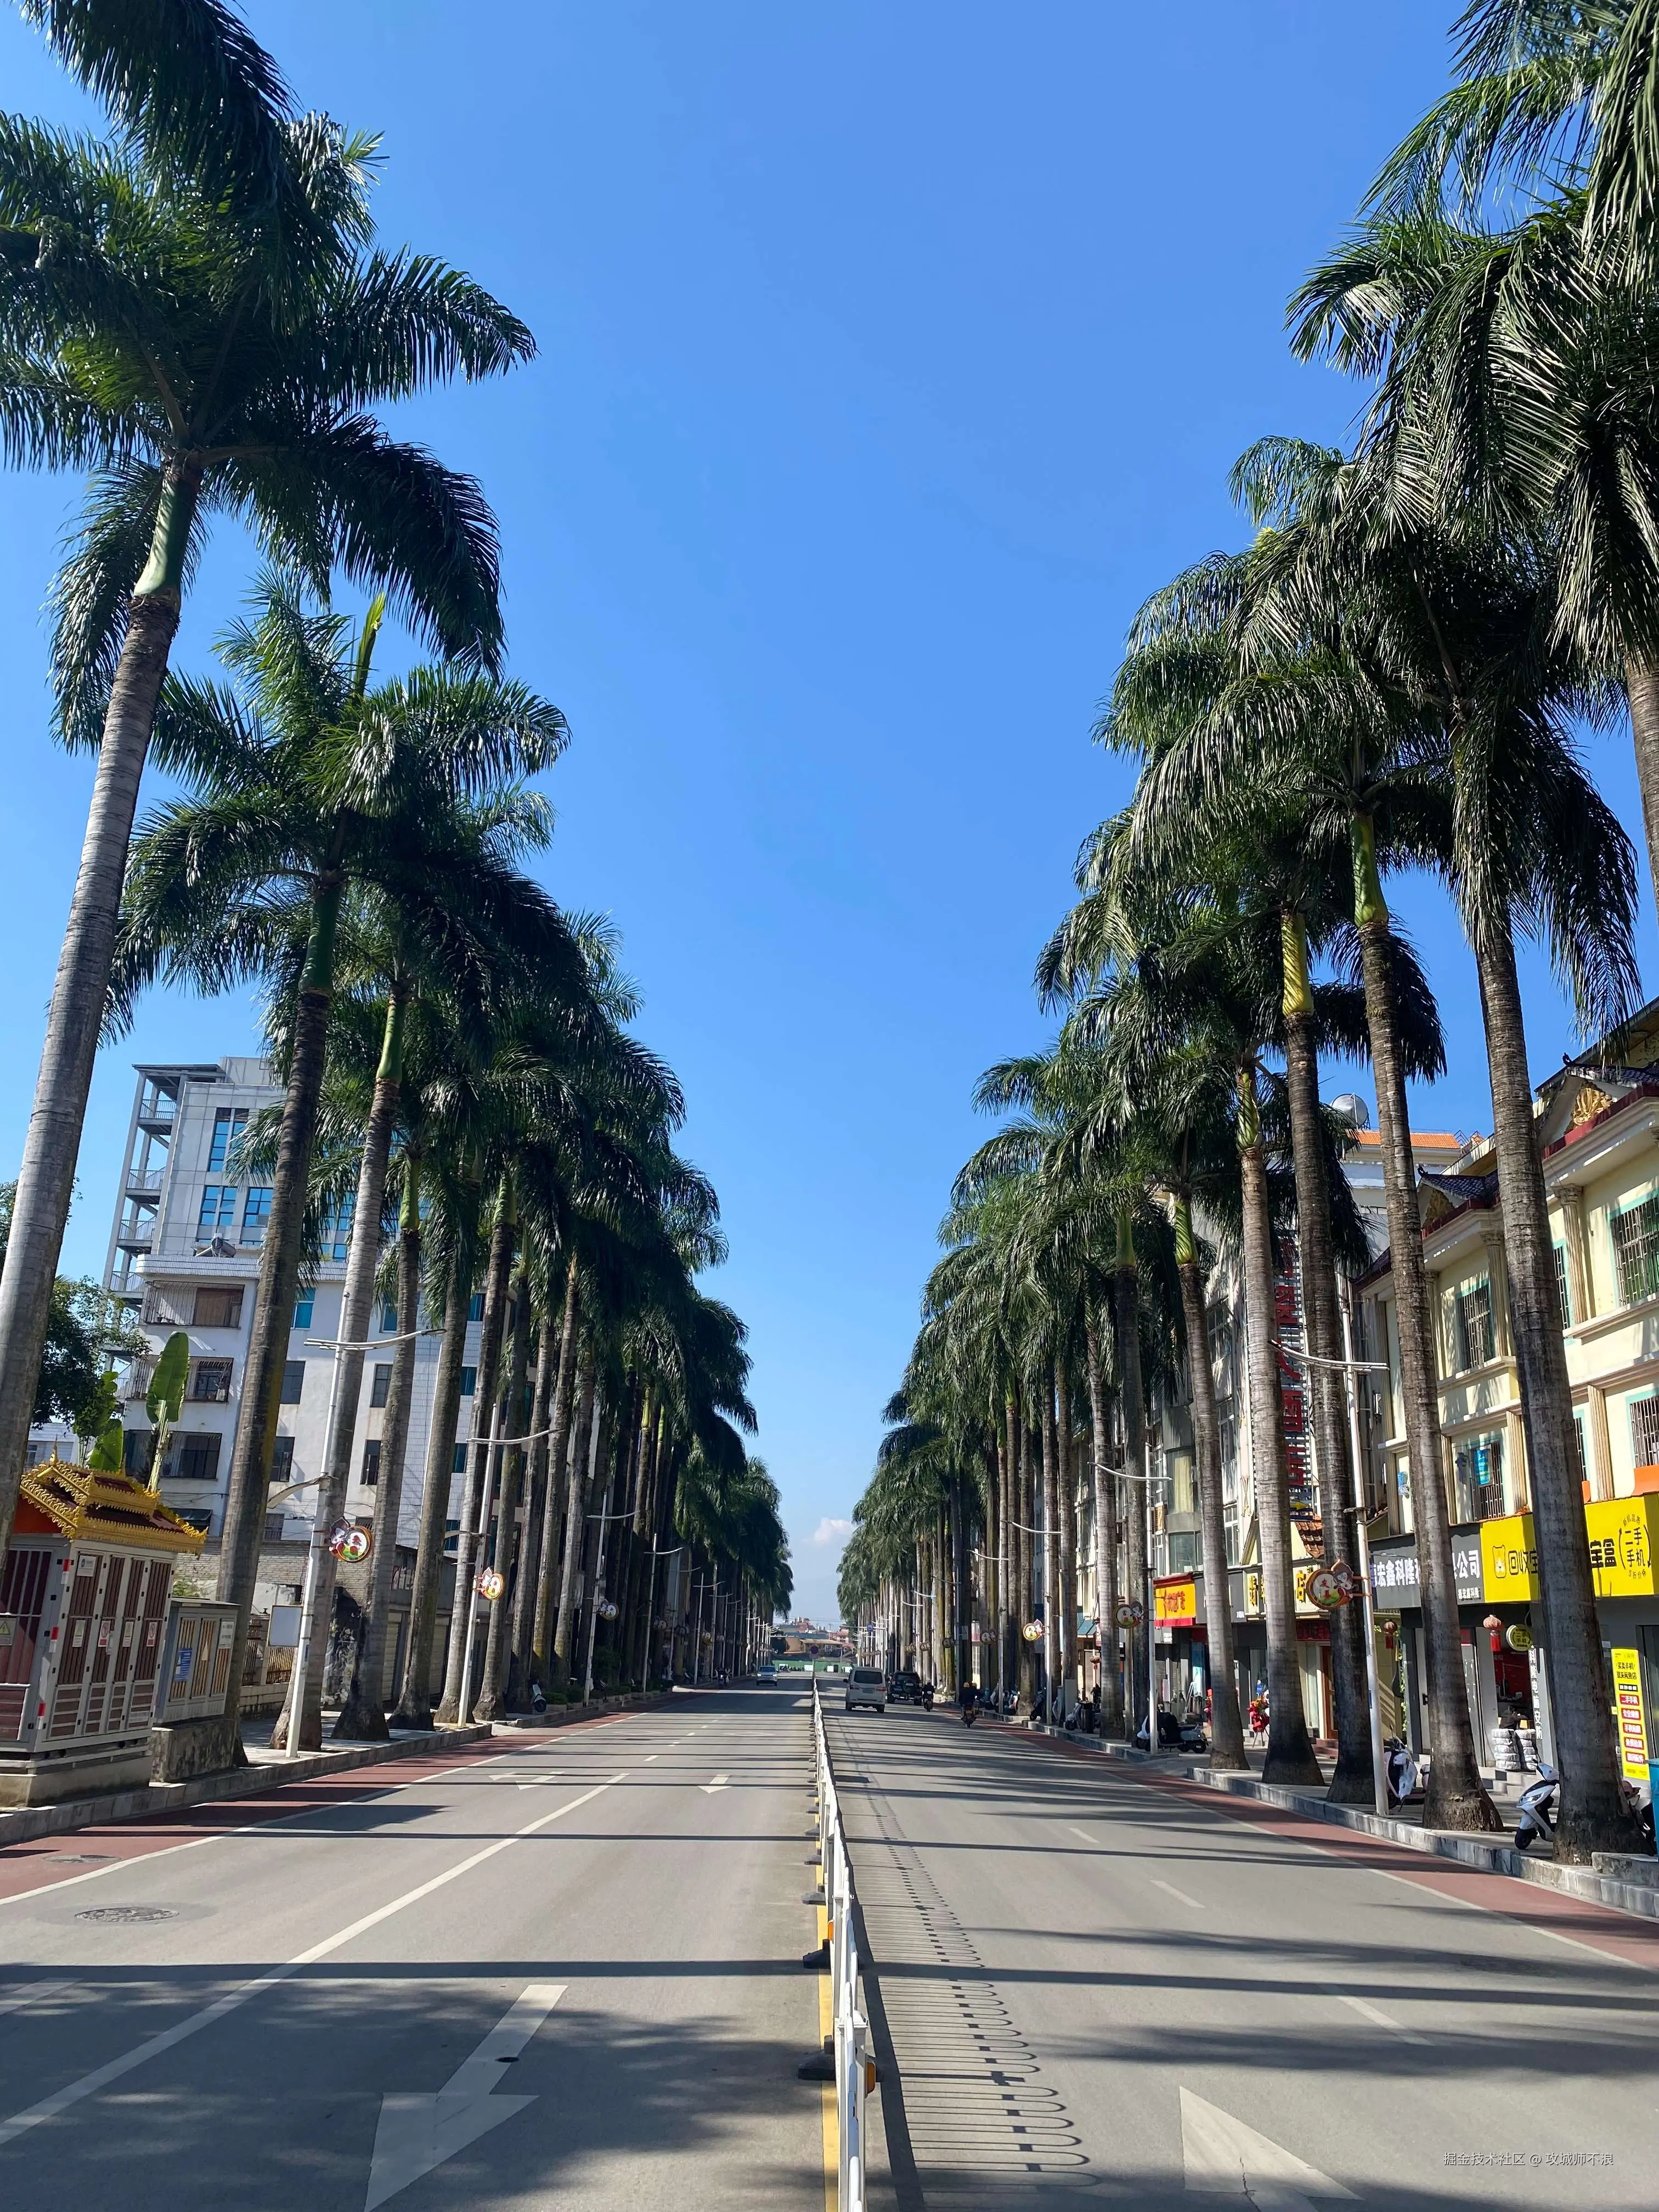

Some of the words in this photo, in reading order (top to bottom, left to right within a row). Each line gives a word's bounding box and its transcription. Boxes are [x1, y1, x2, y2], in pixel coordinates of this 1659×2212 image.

[1625, 1527, 1643, 1545] 二手
[1590, 1538, 1617, 1568] 宝盒
[1626, 1548, 1646, 1567] 手机
